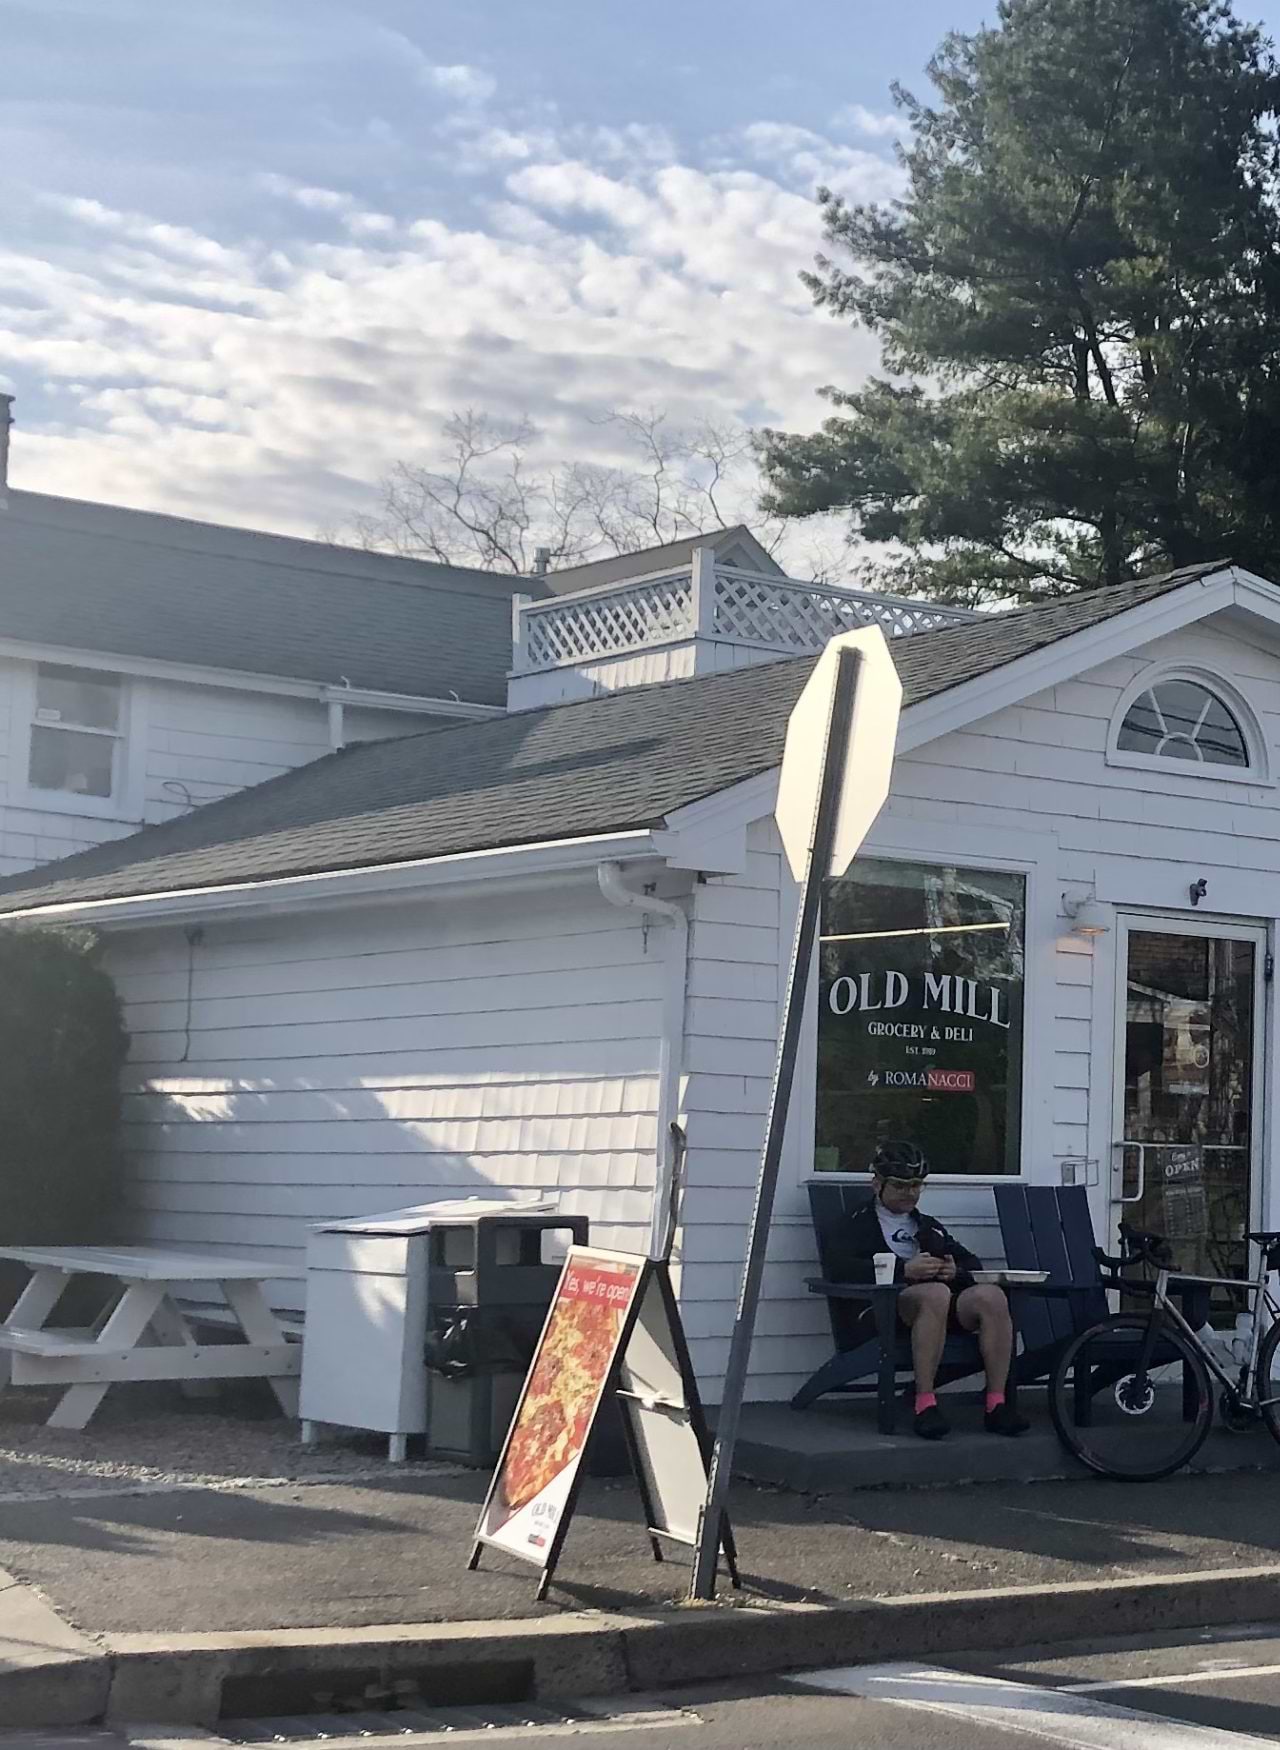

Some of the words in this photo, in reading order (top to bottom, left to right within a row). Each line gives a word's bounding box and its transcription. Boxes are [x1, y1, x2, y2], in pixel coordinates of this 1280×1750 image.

[829, 970, 909, 1015] OLD
[922, 972, 1010, 1029] MILL
[867, 1021, 927, 1039] GROCERY
[930, 1025, 941, 1040] &
[944, 1026, 973, 1041] DELI
[867, 1069, 880, 1087] by
[884, 1070, 971, 1088] ROMANACCI
[1164, 1157, 1200, 1177] OPEN
